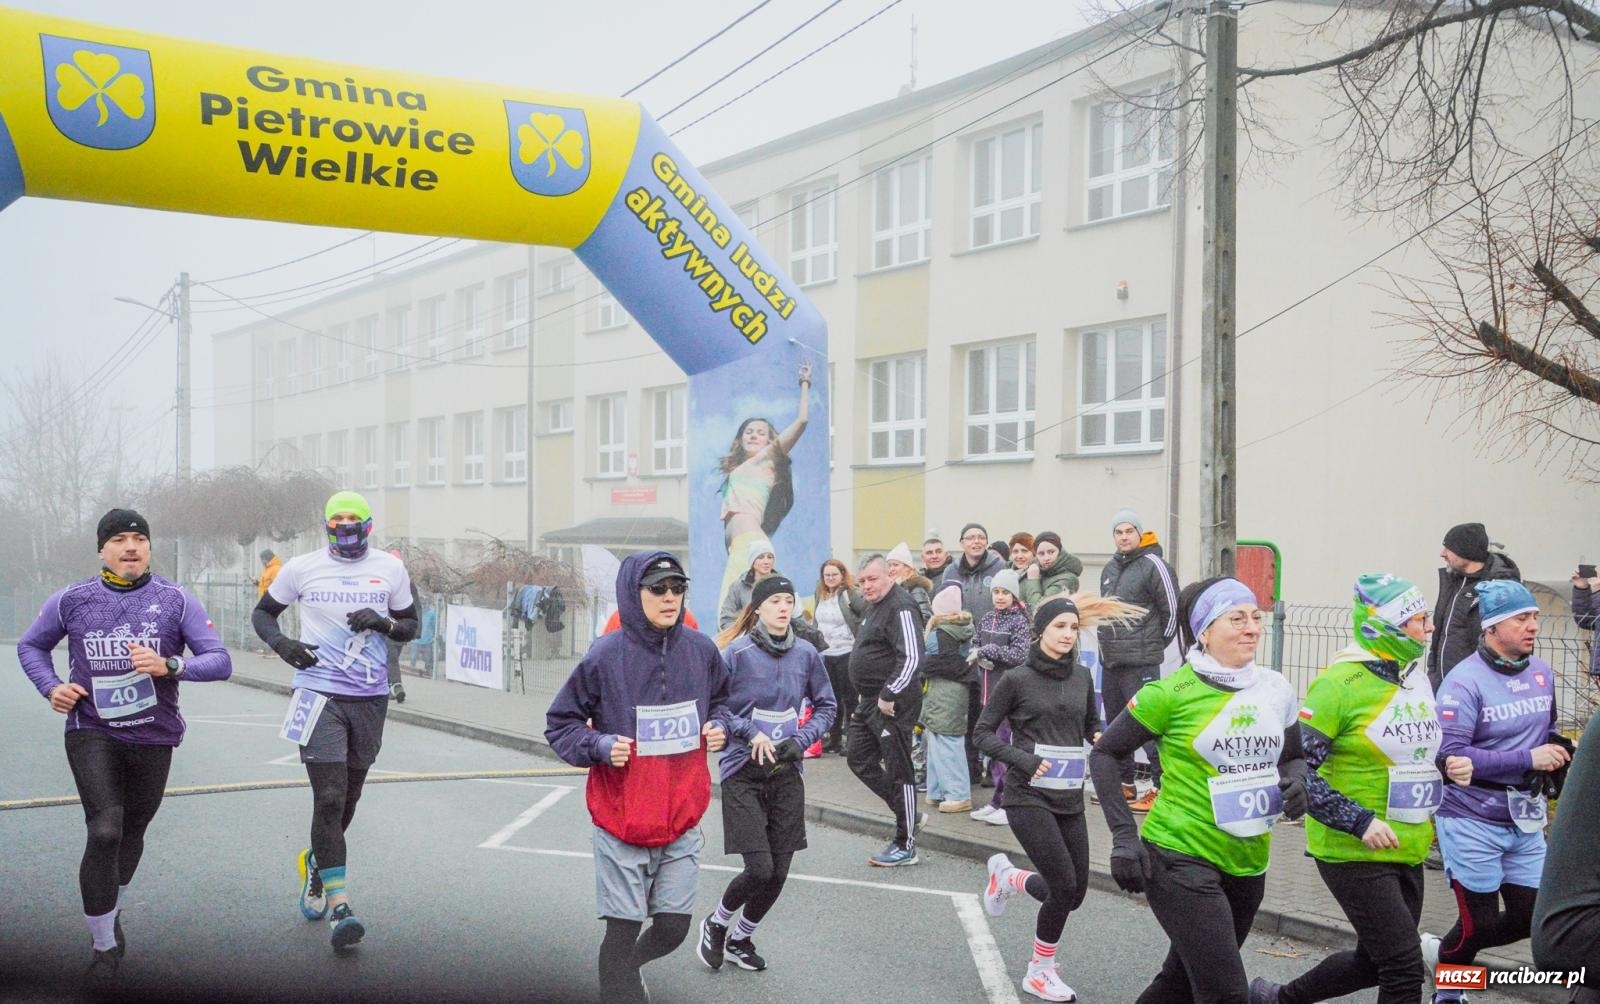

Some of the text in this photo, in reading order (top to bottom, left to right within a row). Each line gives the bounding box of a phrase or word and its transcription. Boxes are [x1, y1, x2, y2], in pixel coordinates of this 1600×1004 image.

[247, 65, 427, 111] Gmina
[200, 92, 475, 155] Pietrowice
[236, 140, 438, 191] Wielkie
[652, 152, 797, 320] Gmina ludzi
[625, 186, 768, 345] aktywnych
[310, 591, 386, 604] RUNNERS
[89, 660, 135, 671] TRIATHLON
[110, 686, 138, 705] 40
[290, 700, 312, 733] 161
[649, 717, 690, 740] 120
[771, 723, 783, 740] 6
[1400, 733, 1437, 743] LYSKI
[1228, 748, 1268, 758] LYSKI
[1057, 760, 1069, 777] 7
[1238, 789, 1270, 818] 90
[1411, 783, 1434, 807] 92
